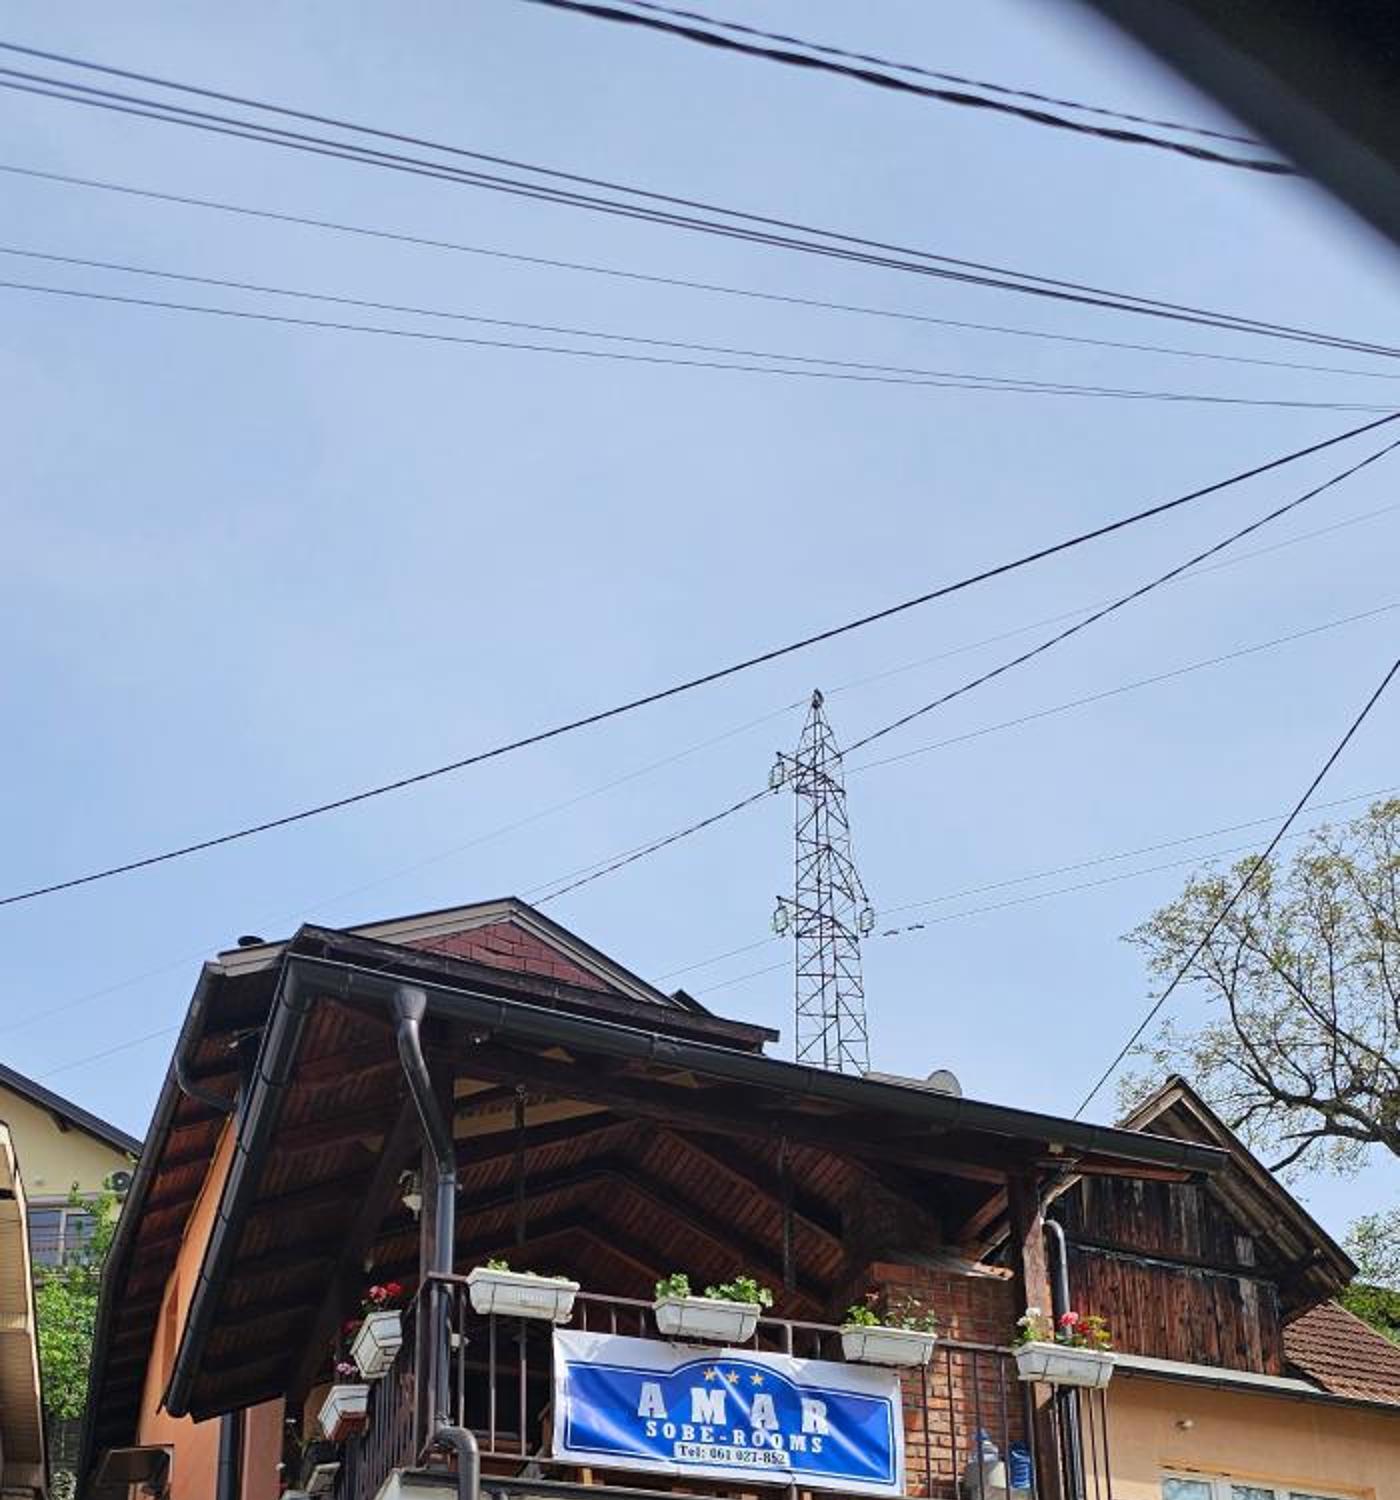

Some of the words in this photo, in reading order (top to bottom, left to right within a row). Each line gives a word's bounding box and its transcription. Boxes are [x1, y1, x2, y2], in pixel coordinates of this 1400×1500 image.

[638, 1382, 829, 1434] AMAR
[679, 1445, 705, 1458] Tel:
[710, 1447, 731, 1461] 061
